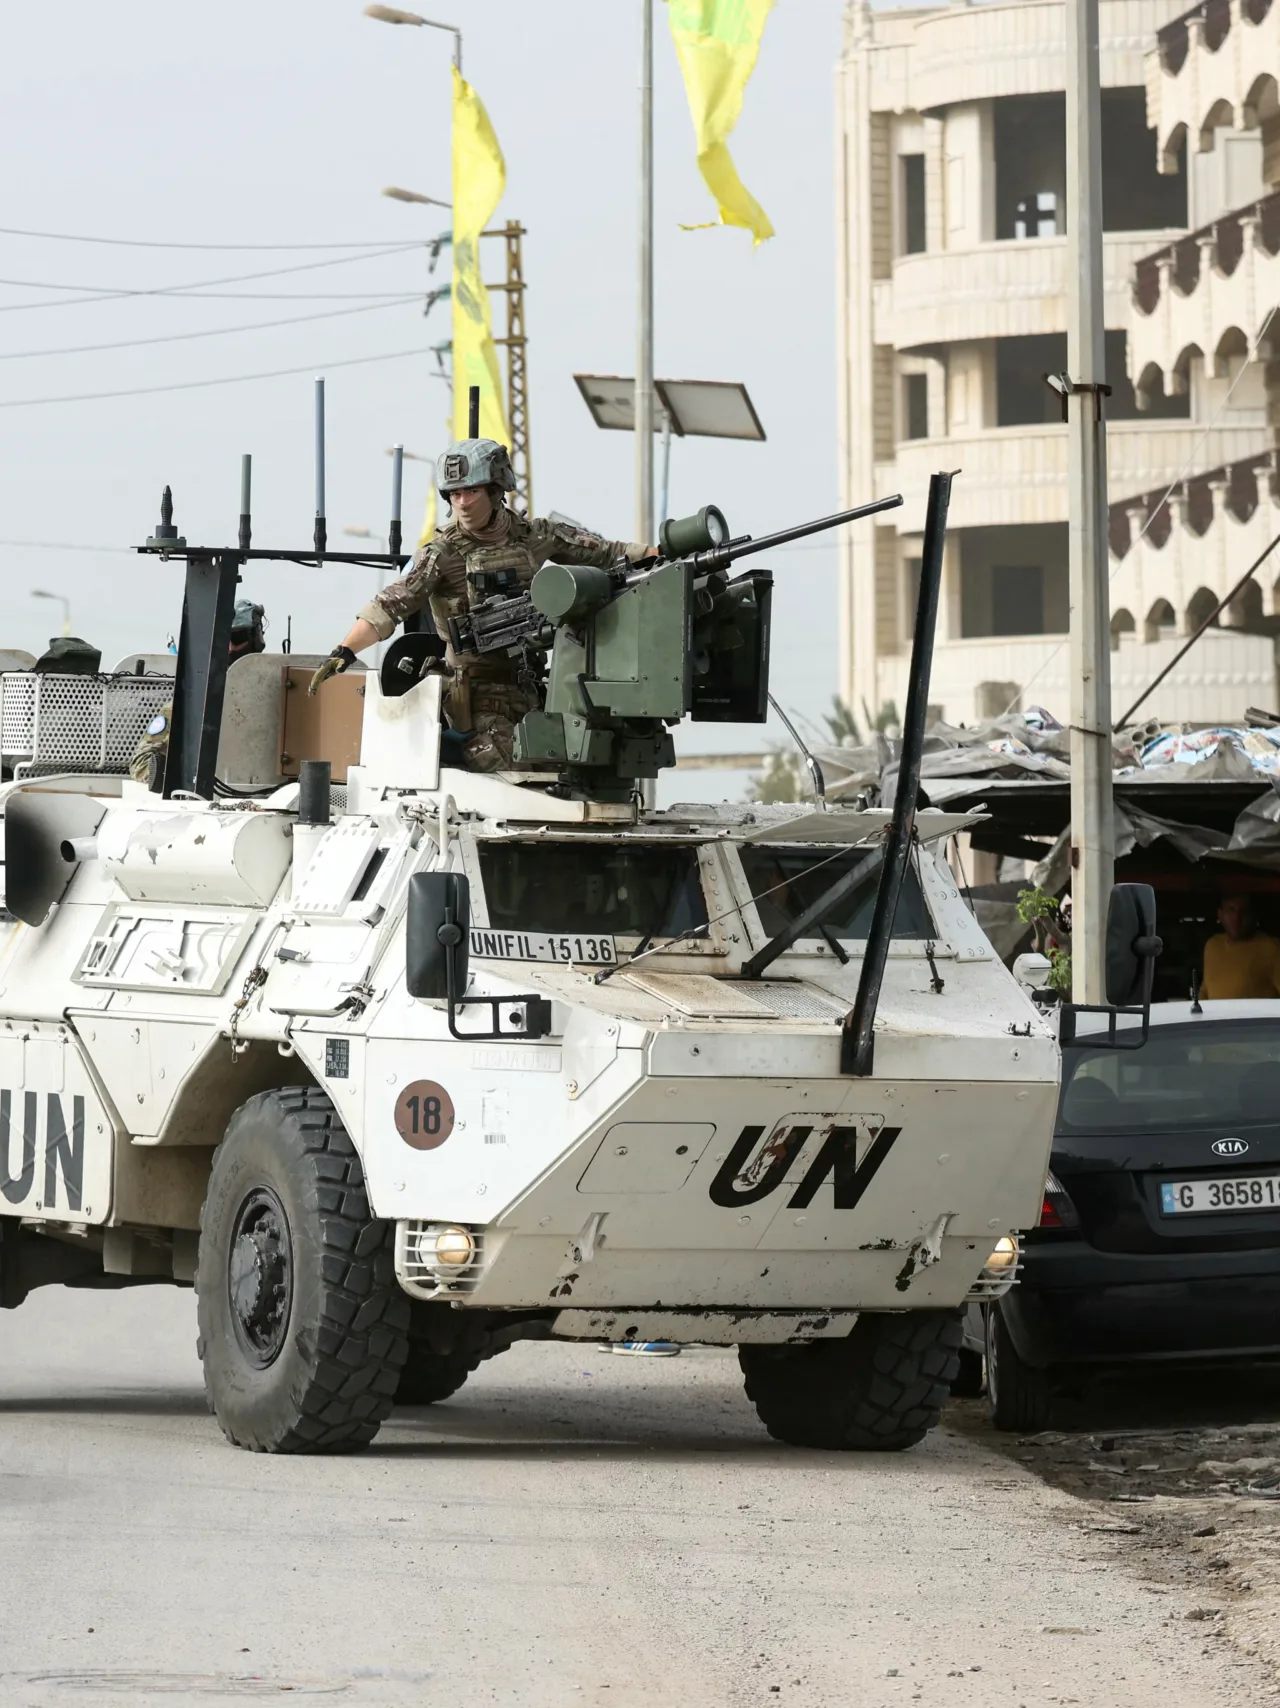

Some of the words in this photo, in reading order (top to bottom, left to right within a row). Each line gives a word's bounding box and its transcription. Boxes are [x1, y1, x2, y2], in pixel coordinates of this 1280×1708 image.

[471, 931, 612, 961] UNIFIL-15136
[406, 1095, 441, 1135] 18
[1217, 1142, 1243, 1153] KIA
[708, 1125, 903, 1209] UN
[1180, 1185, 1194, 1209] G
[1208, 1180, 1280, 1207] 36581
